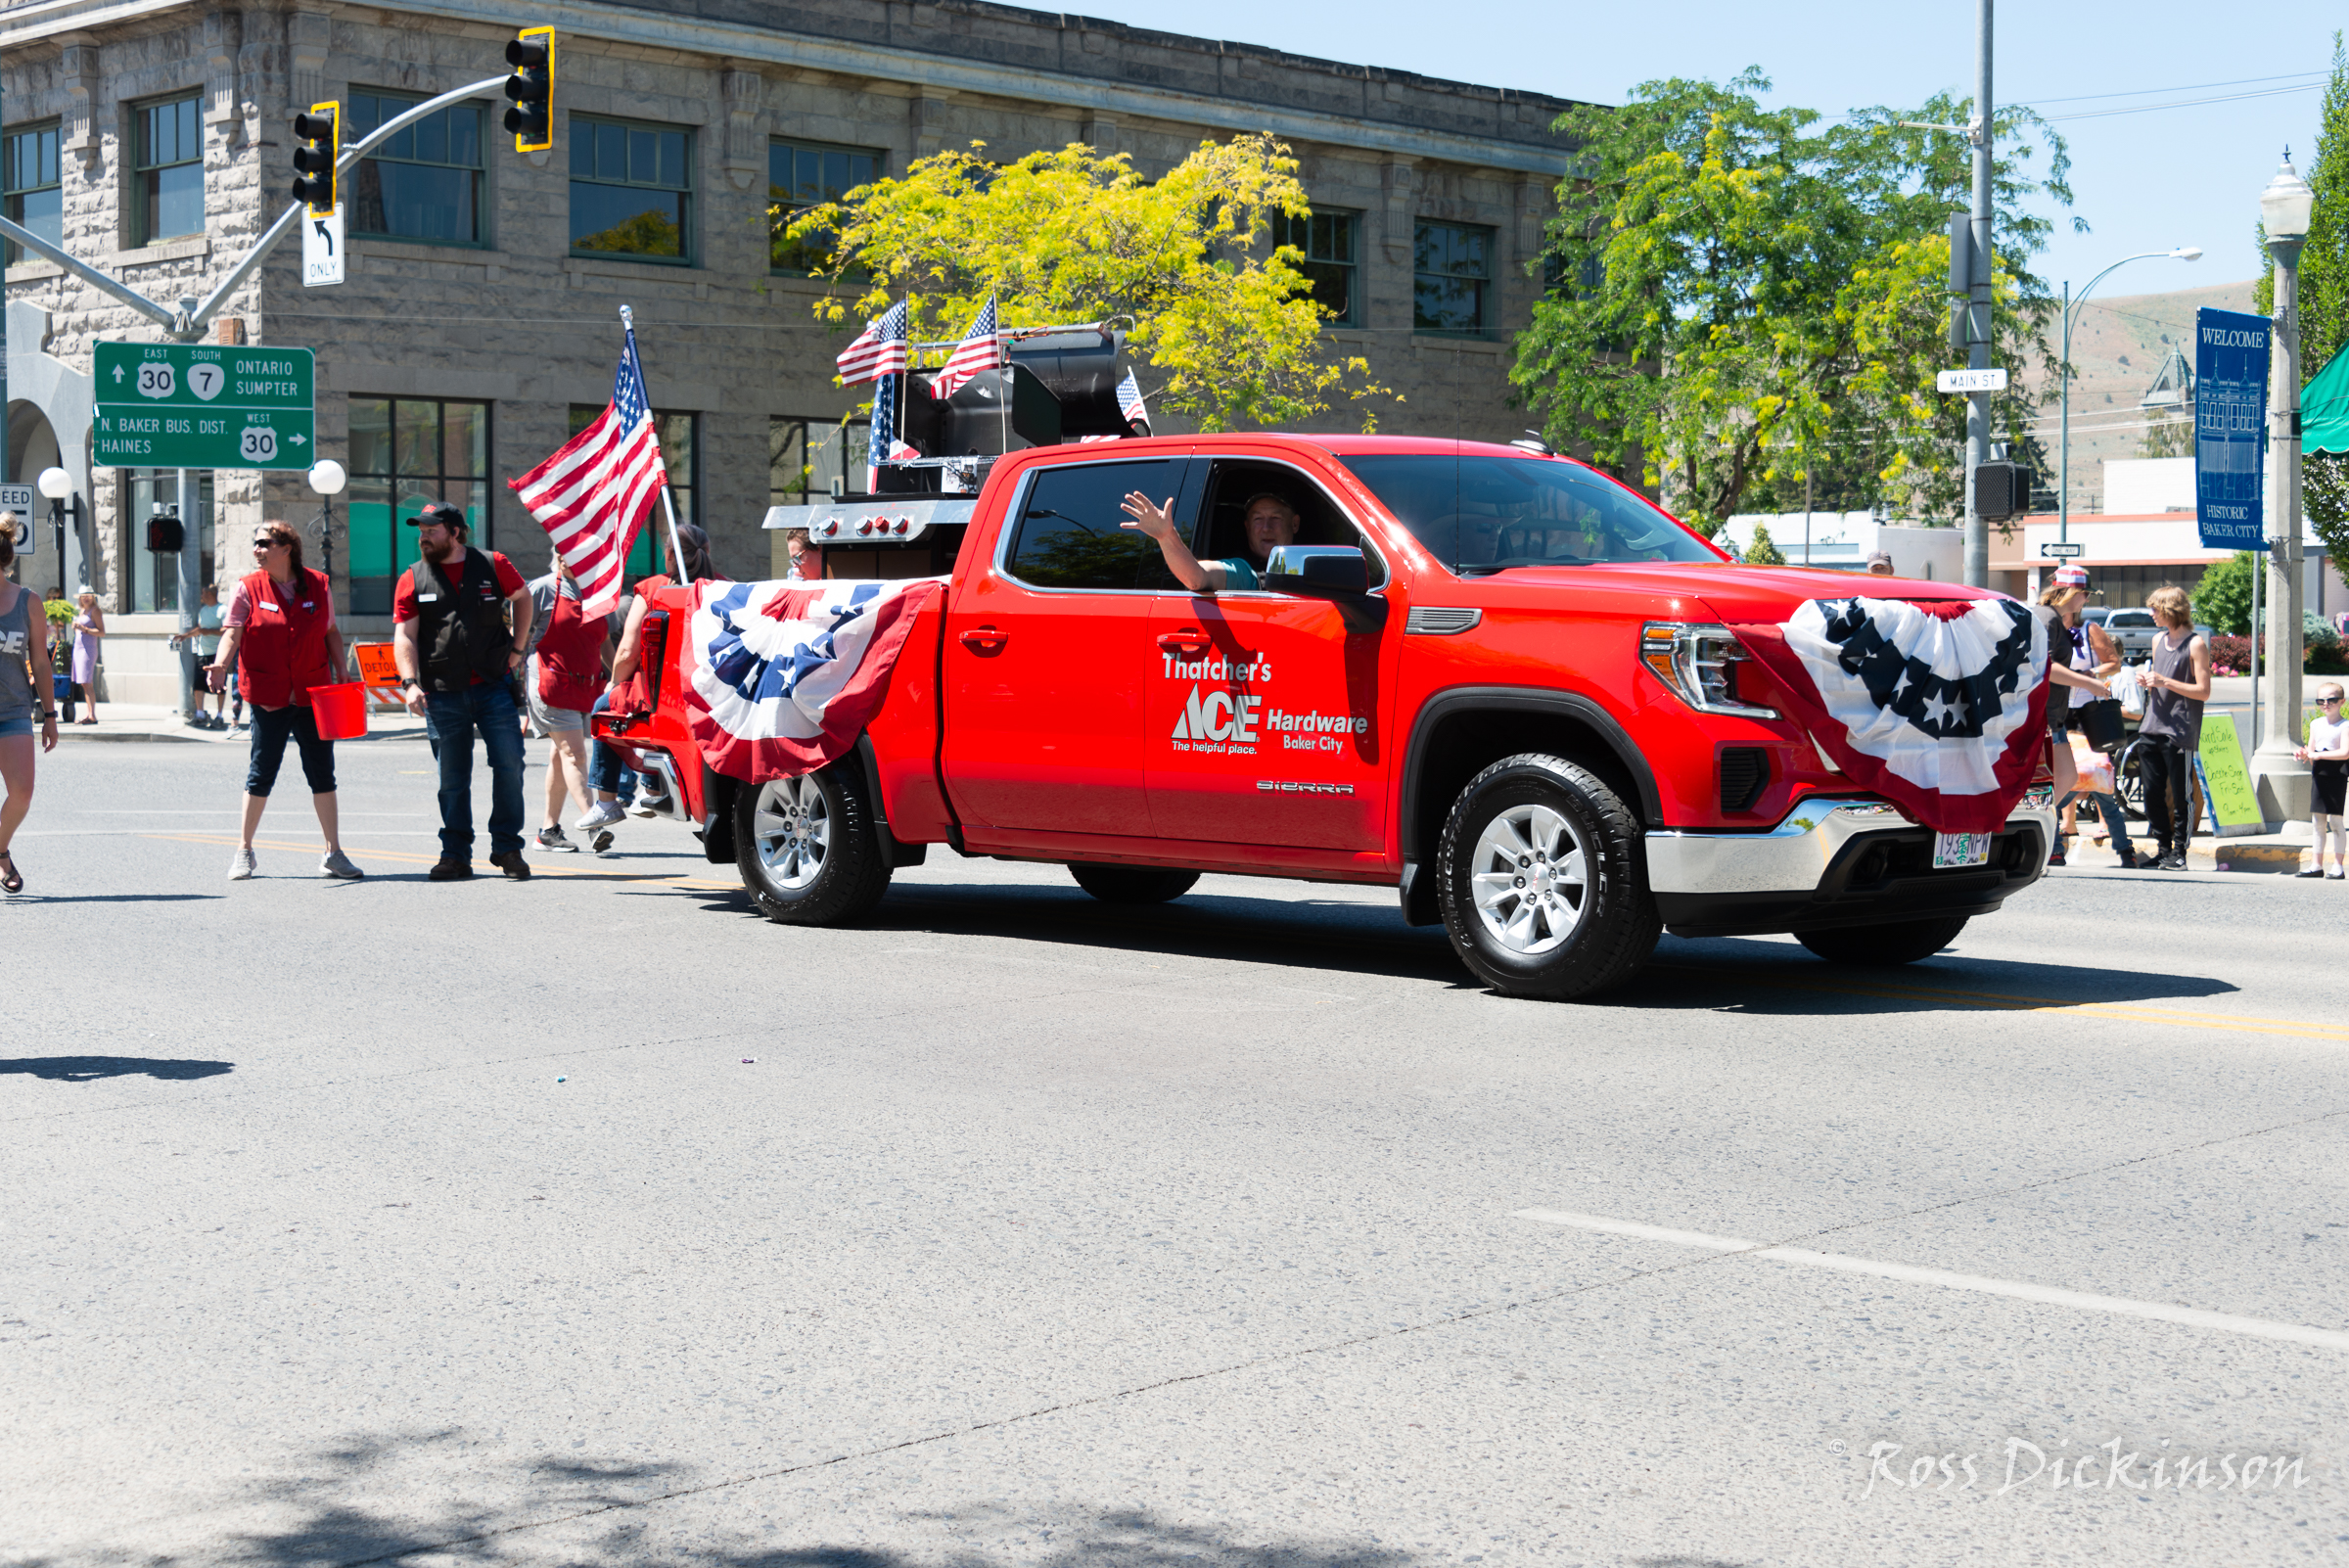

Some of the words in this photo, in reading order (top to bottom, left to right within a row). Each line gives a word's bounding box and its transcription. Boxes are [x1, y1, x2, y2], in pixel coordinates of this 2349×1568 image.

[310, 261, 338, 278] ONLY
[2202, 328, 2264, 347] WELCOME
[144, 348, 168, 359] EAST
[191, 350, 221, 361] SOUTH
[236, 360, 293, 376] ONTARIO
[142, 370, 171, 391] 30
[199, 372, 212, 392] 7
[1950, 375, 1976, 388] MAIN
[236, 382, 298, 396] SUMPTER
[247, 413, 270, 423] WEST
[101, 418, 113, 432] N.
[119, 418, 160, 434] BAKER
[166, 419, 193, 435] BUS.
[199, 420, 229, 435] DIST.
[102, 439, 152, 454] HAINES
[245, 434, 273, 454] 30
[0, 490, 29, 504] EED
[2206, 504, 2249, 520] HISTORIC
[2202, 522, 2234, 537] BAKER
[2235, 525, 2258, 538] CITY
[365, 662, 398, 673] DETOU
[1162, 652, 1271, 682] Thatcher's
[1171, 681, 1263, 743] ACE
[1267, 708, 1368, 734] Hardware
[2200, 726, 2216, 744] ard
[1172, 740, 1190, 752] The
[1192, 742, 1225, 755] helpful
[1228, 743, 1257, 756] place.
[1283, 735, 1316, 751] Baker
[1318, 736, 1343, 755] City
[1256, 780, 1354, 794] SIERRA
